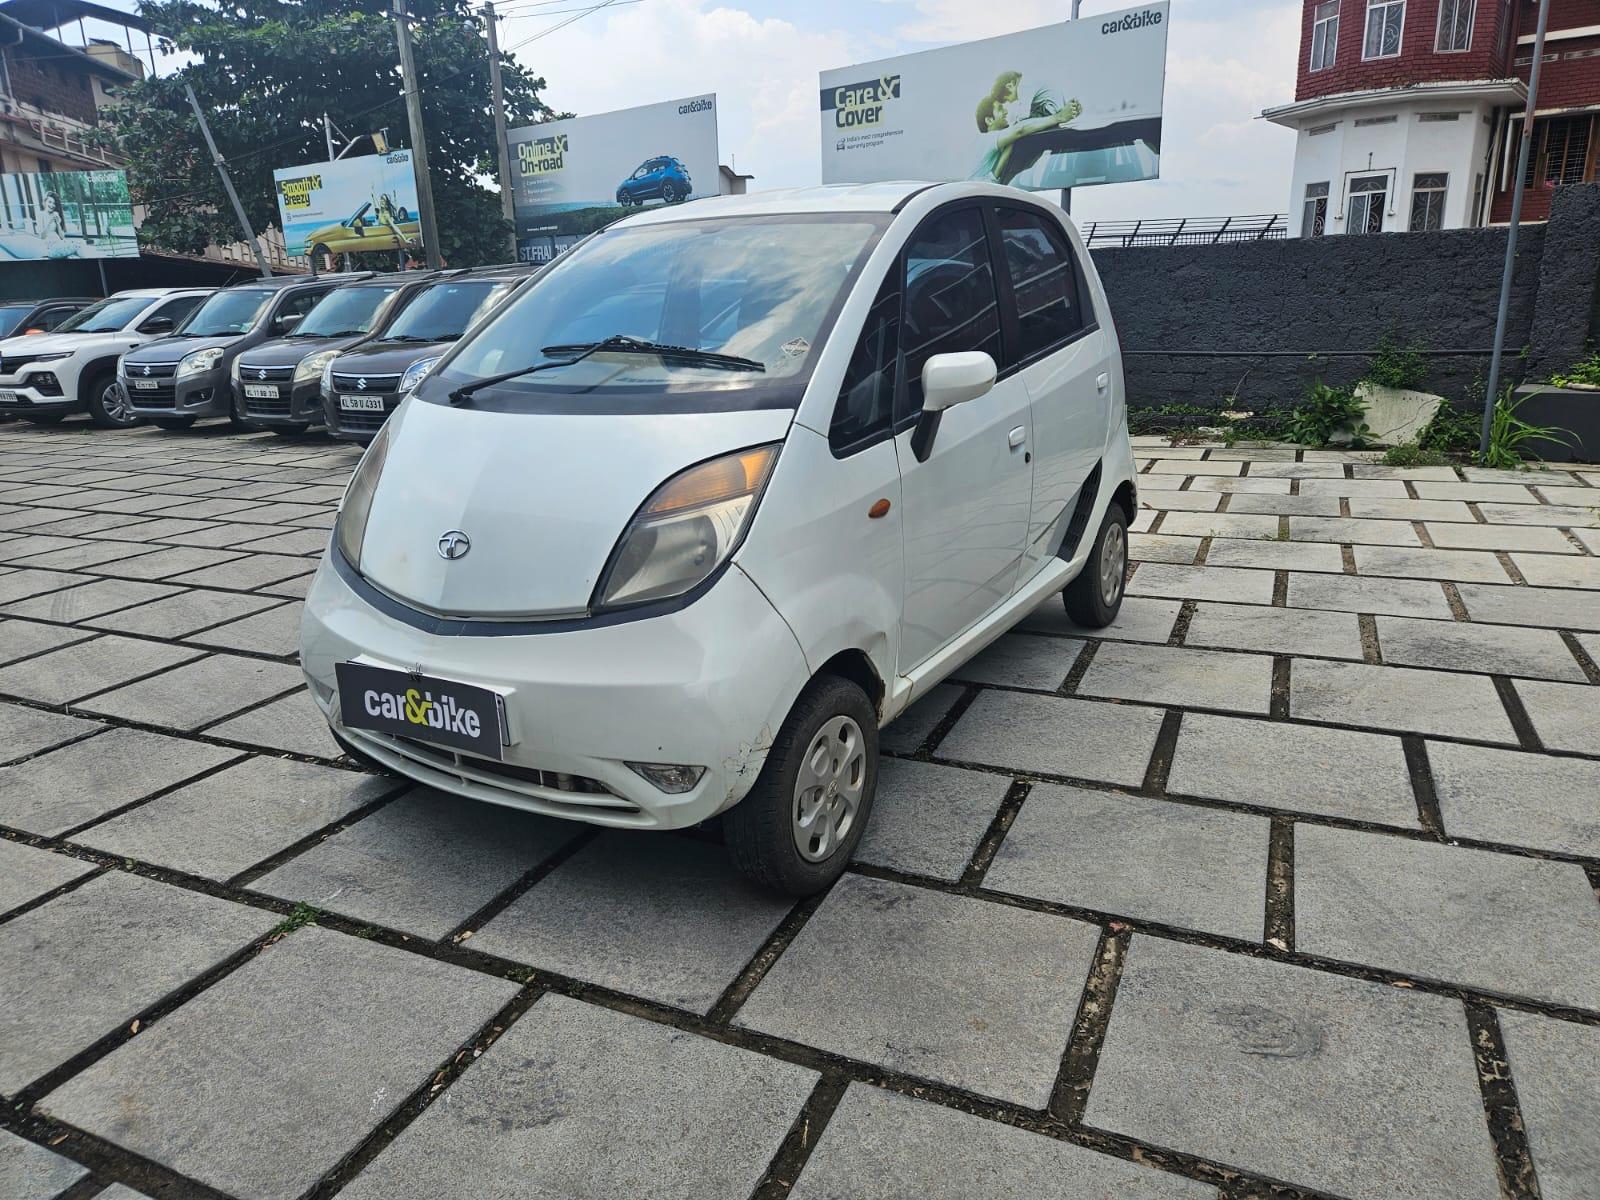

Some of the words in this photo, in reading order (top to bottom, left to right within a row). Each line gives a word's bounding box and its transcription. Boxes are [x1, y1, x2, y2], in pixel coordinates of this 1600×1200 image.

[1101, 10, 1163, 36] car&bike
[835, 86, 875, 109] Care
[877, 74, 901, 101] &
[678, 99, 713, 115] car&bike
[835, 106, 883, 129] Cover
[518, 139, 551, 161] Online
[553, 134, 569, 154] &
[519, 152, 564, 174] On-road
[281, 176, 312, 194] Smooth
[284, 193, 311, 207] Breezy
[342, 399, 349, 407] KL
[365, 399, 382, 409] 4331
[364, 688, 481, 738] car&bike
